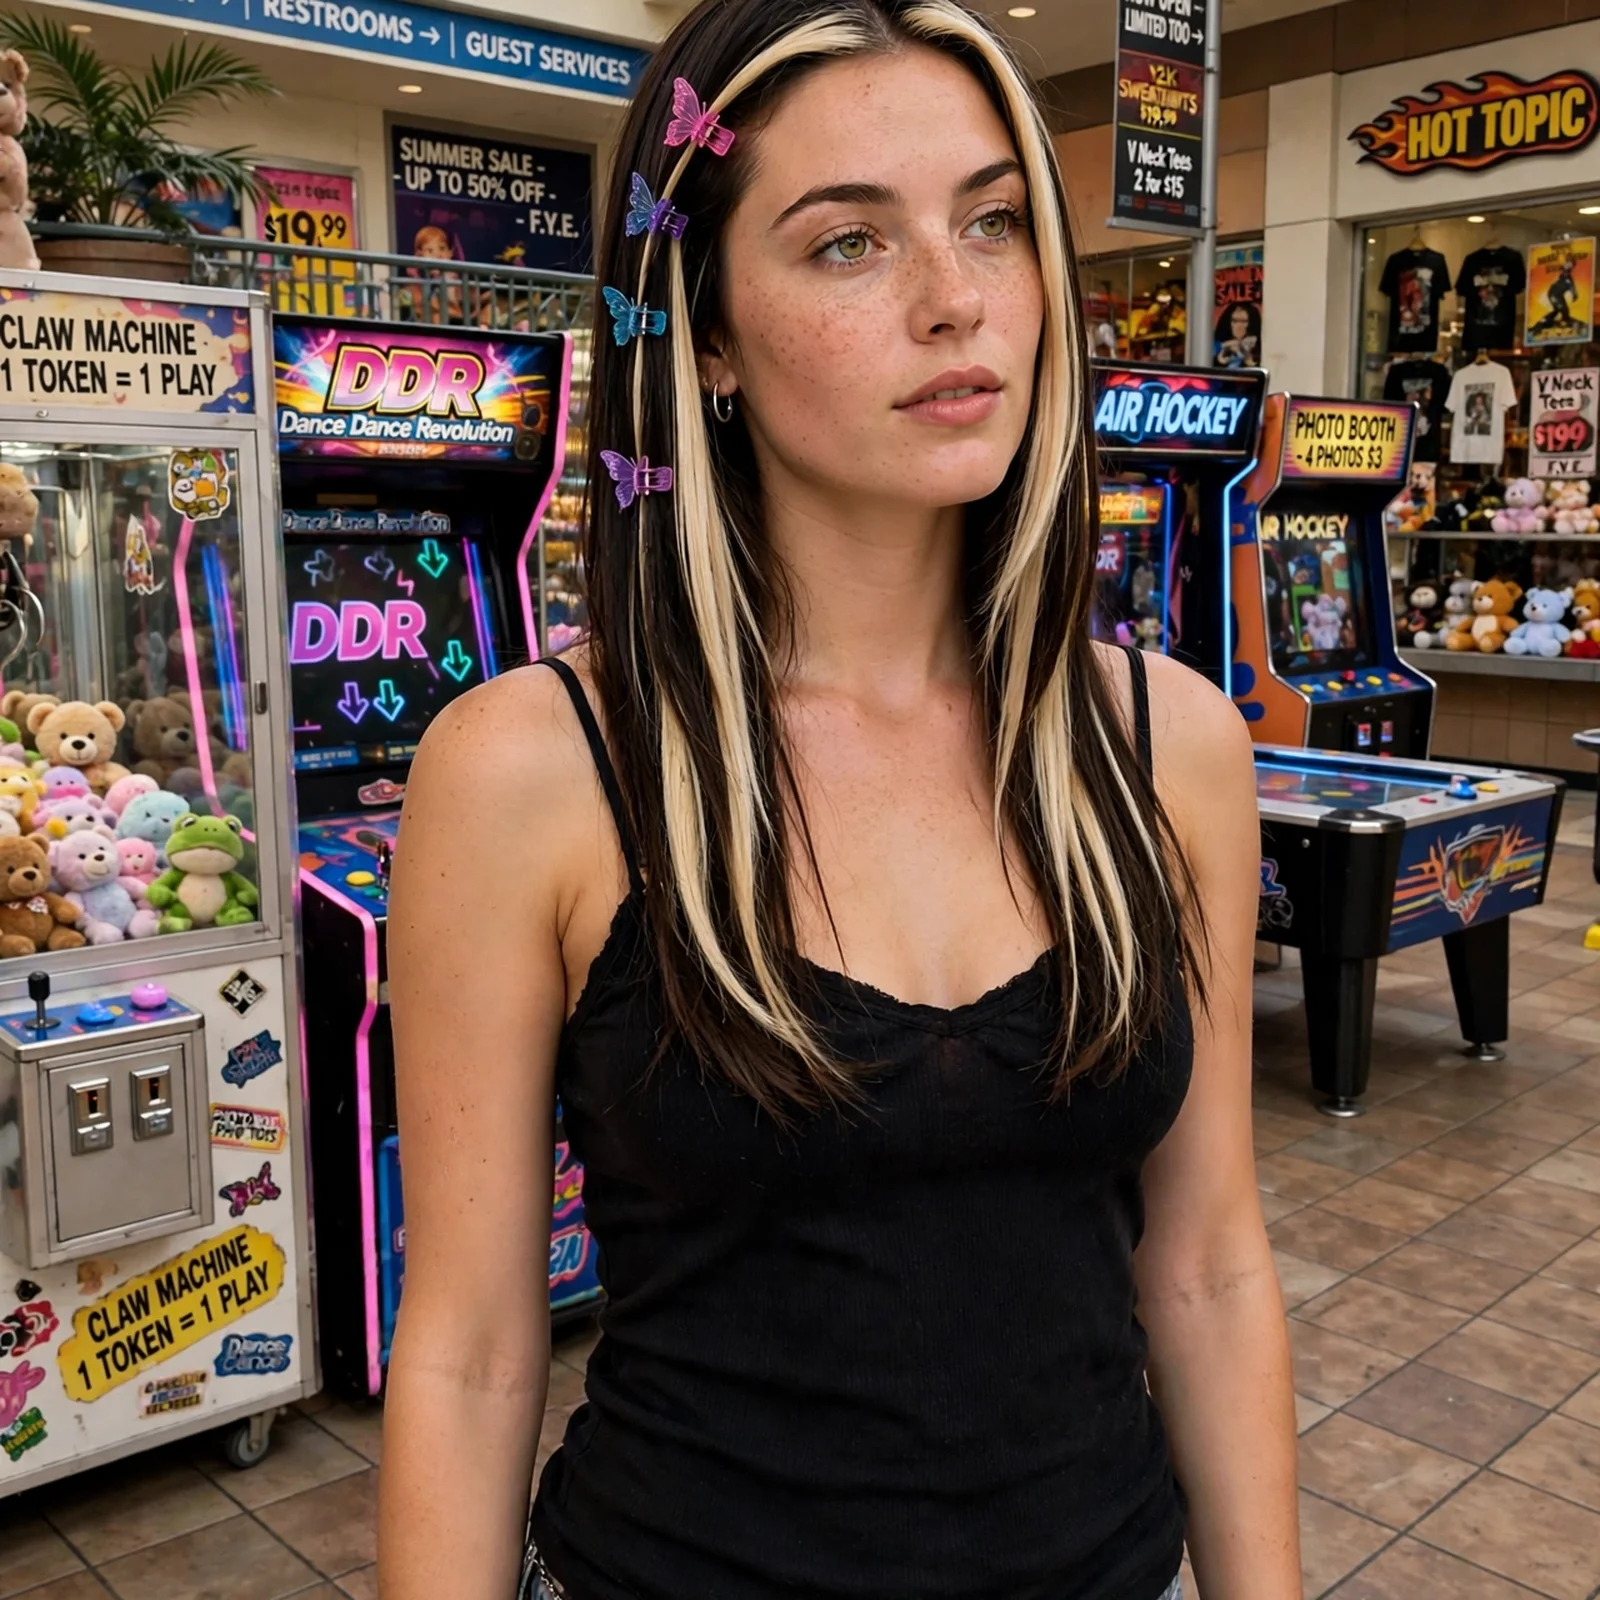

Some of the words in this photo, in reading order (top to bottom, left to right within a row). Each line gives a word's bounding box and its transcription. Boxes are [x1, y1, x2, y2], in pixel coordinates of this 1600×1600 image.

[263, 0, 413, 44] RESTROOMS
[1125, 8, 1167, 39] LIMITED
[1168, 18, 1191, 45] TOO
[466, 31, 534, 66] GUEST
[539, 45, 631, 85] SERVICES
[1408, 107, 1473, 161] HOT
[1481, 87, 1586, 149] TOPIC
[401, 137, 484, 172] SUMMER
[488, 149, 533, 177] SALE
[1127, 139, 1137, 163] V
[1138, 141, 1166, 168] Neck
[1167, 147, 1193, 172] Tees
[405, 165, 432, 191] UP
[437, 170, 462, 195] TO
[468, 174, 506, 200] 50%
[510, 180, 545, 204] OFF
[1133, 168, 1143, 191] 2
[1145, 171, 1161, 194] for
[1164, 174, 1184, 199] $15
[529, 209, 579, 239] F.Y.E.
[0, 314, 74, 351] CLAW
[85, 319, 197, 355] MACHINE
[1, 358, 12, 391] 1
[23, 358, 107, 394] TOKEN
[140, 362, 151, 394] 1
[161, 363, 216, 396] PLAY
[327, 345, 484, 417] DDR
[1536, 375, 1548, 393] V
[1552, 373, 1593, 391] Neck
[280, 409, 346, 435] Dance
[349, 414, 411, 438] Dance
[415, 417, 514, 442] Revolution
[1095, 390, 1143, 433] AIR
[1145, 392, 1248, 435] HOCKEY
[1296, 412, 1344, 439] PHOTO
[1348, 415, 1396, 442] BOOTH
[1305, 445, 1314, 467] 4
[1316, 445, 1363, 468] PHOTOS
[1367, 445, 1383, 469] $3
[291, 600, 428, 663] DDR
[87, 1286, 149, 1343] CLAW
[155, 1233, 252, 1308] MACHINE
[77, 1360, 92, 1390] 1
[96, 1315, 174, 1380] TOKEN
[200, 1294, 213, 1323] 1
[218, 1261, 269, 1314] PLAY
